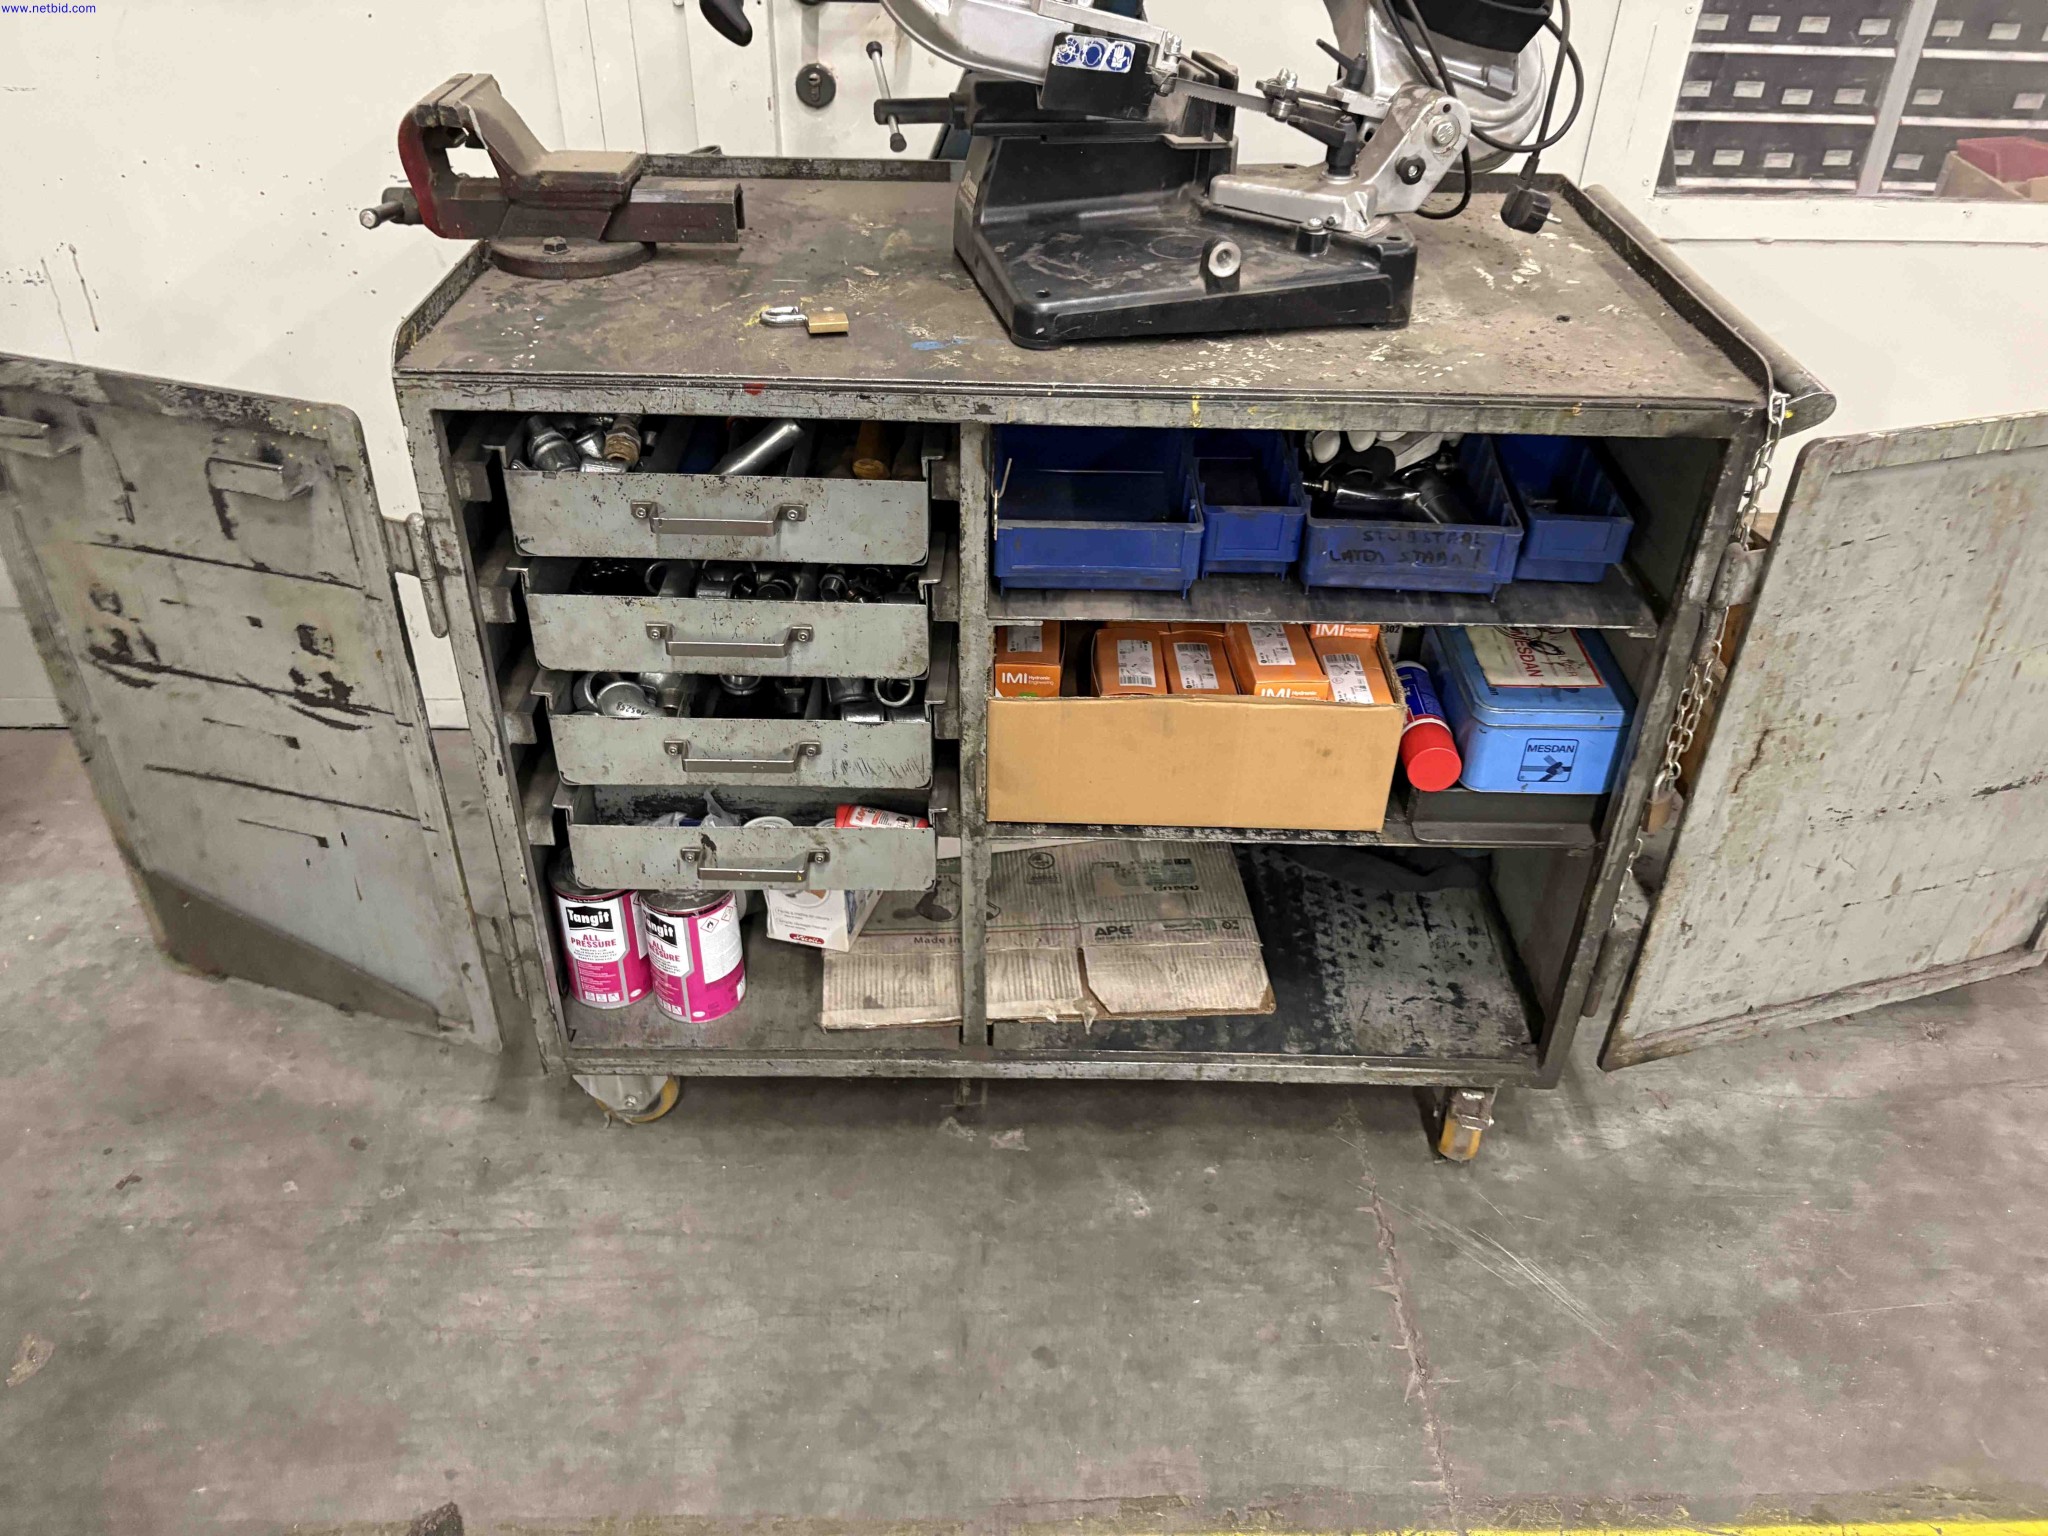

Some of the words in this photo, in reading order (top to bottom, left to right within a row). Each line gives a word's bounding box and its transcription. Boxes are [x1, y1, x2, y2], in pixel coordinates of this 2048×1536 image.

[1315, 624, 1344, 636] IMI
[1001, 672, 1028, 684] IMI
[1527, 744, 1576, 753] MESDAN
[567, 909, 610, 927] Tangit
[646, 918, 674, 938] angit
[571, 936, 617, 948] PRESSURE
[582, 934, 600, 942] ALL
[913, 936, 946, 944] Made
